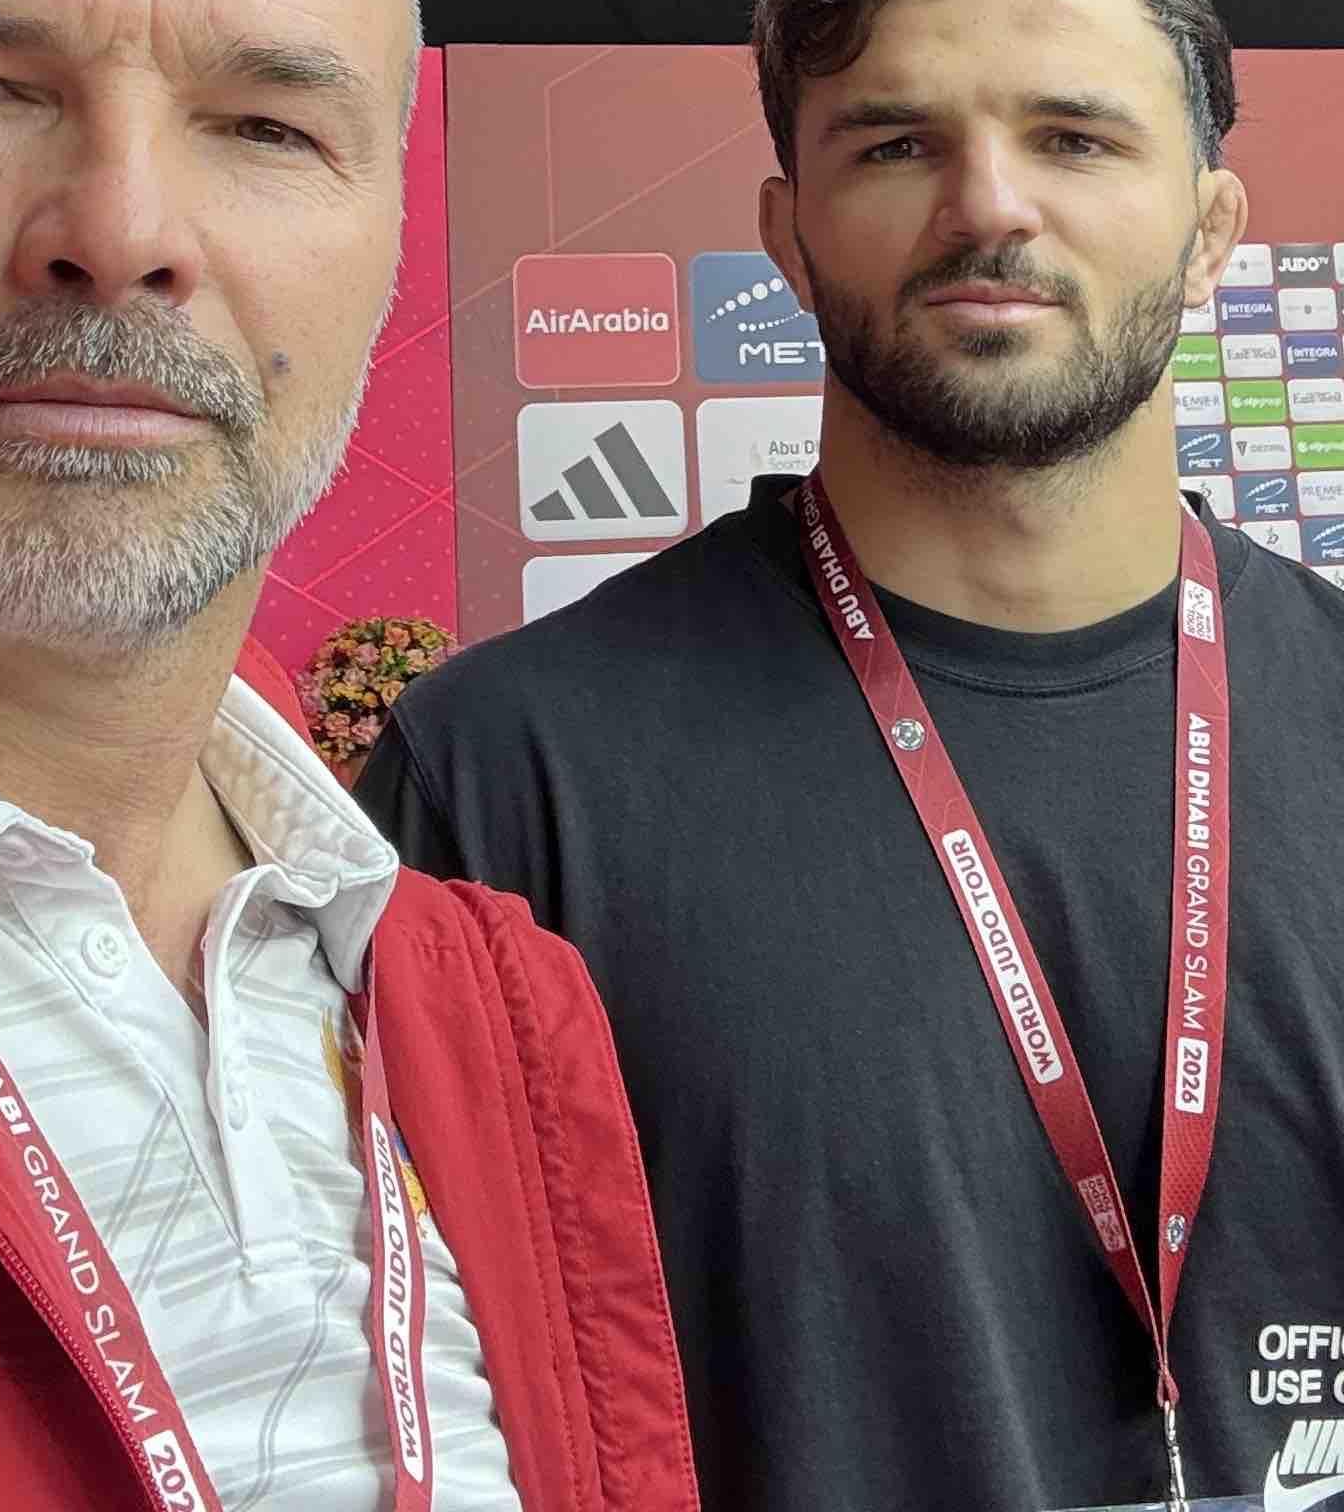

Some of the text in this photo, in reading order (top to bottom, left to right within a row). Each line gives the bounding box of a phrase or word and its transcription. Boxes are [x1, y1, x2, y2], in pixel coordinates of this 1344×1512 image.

[525, 307, 670, 335] AirArabia
[768, 440, 799, 455] Abu
[810, 524, 850, 595] DHABI
[837, 592, 875, 640] ABU
[1181, 712, 1212, 1105] ABU DHABI GRAND SLAM 2026
[950, 837, 1056, 1076] WORLD JUDO TOUR
[23, 1144, 100, 1296] GRAND
[84, 1304, 158, 1424] SLAM
[375, 1129, 419, 1459] WORLD JUDO TOUR
[1250, 1370, 1322, 1406] USE
